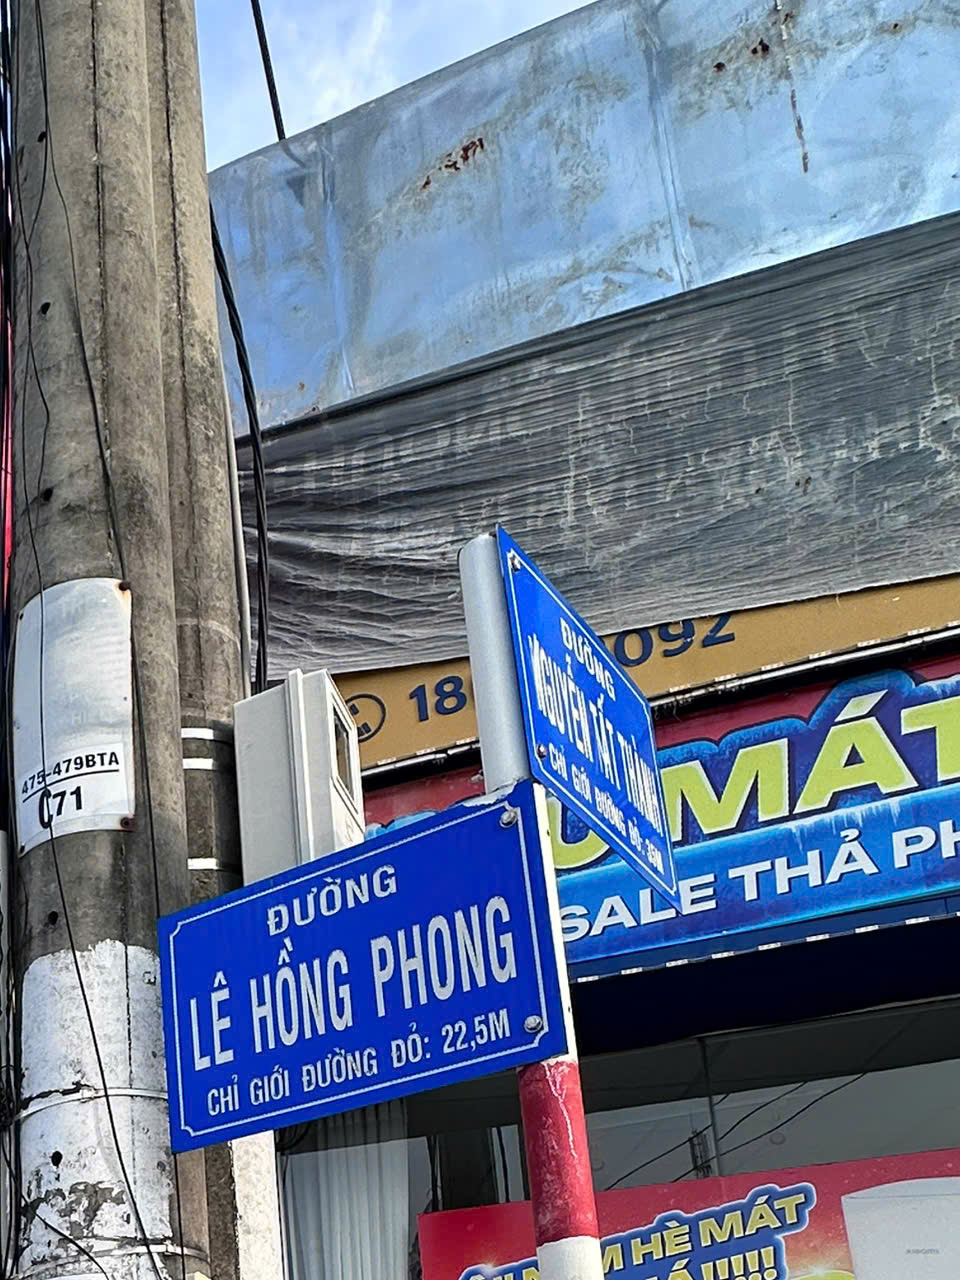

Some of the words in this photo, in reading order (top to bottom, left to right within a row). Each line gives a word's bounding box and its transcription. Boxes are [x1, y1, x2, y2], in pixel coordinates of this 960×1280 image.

[560, 616, 616, 700] ĐƯỜNG
[528, 632, 594, 763] NGUYỄN
[589, 692, 621, 791] TẤT
[616, 730, 664, 838] THÀNH
[595, 786, 627, 837] ĐƯỜNG
[267, 865, 398, 936] ĐƯỜNG
[559, 872, 717, 942] SALE
[728, 828, 879, 902] THẢ
[190, 971, 234, 1071] LÊ
[250, 938, 354, 1054] HỒNG
[370, 896, 517, 1017] PHONG
[207, 1074, 240, 1116] CHỈ
[250, 1065, 290, 1106] GIỚI
[302, 1047, 379, 1092] ĐƯỜNG
[391, 1023, 431, 1069] ĐỎ:
[441, 1008, 511, 1055] 22,5M
[632, 1221, 692, 1266] HÈ
[698, 1194, 806, 1248] MÁT
